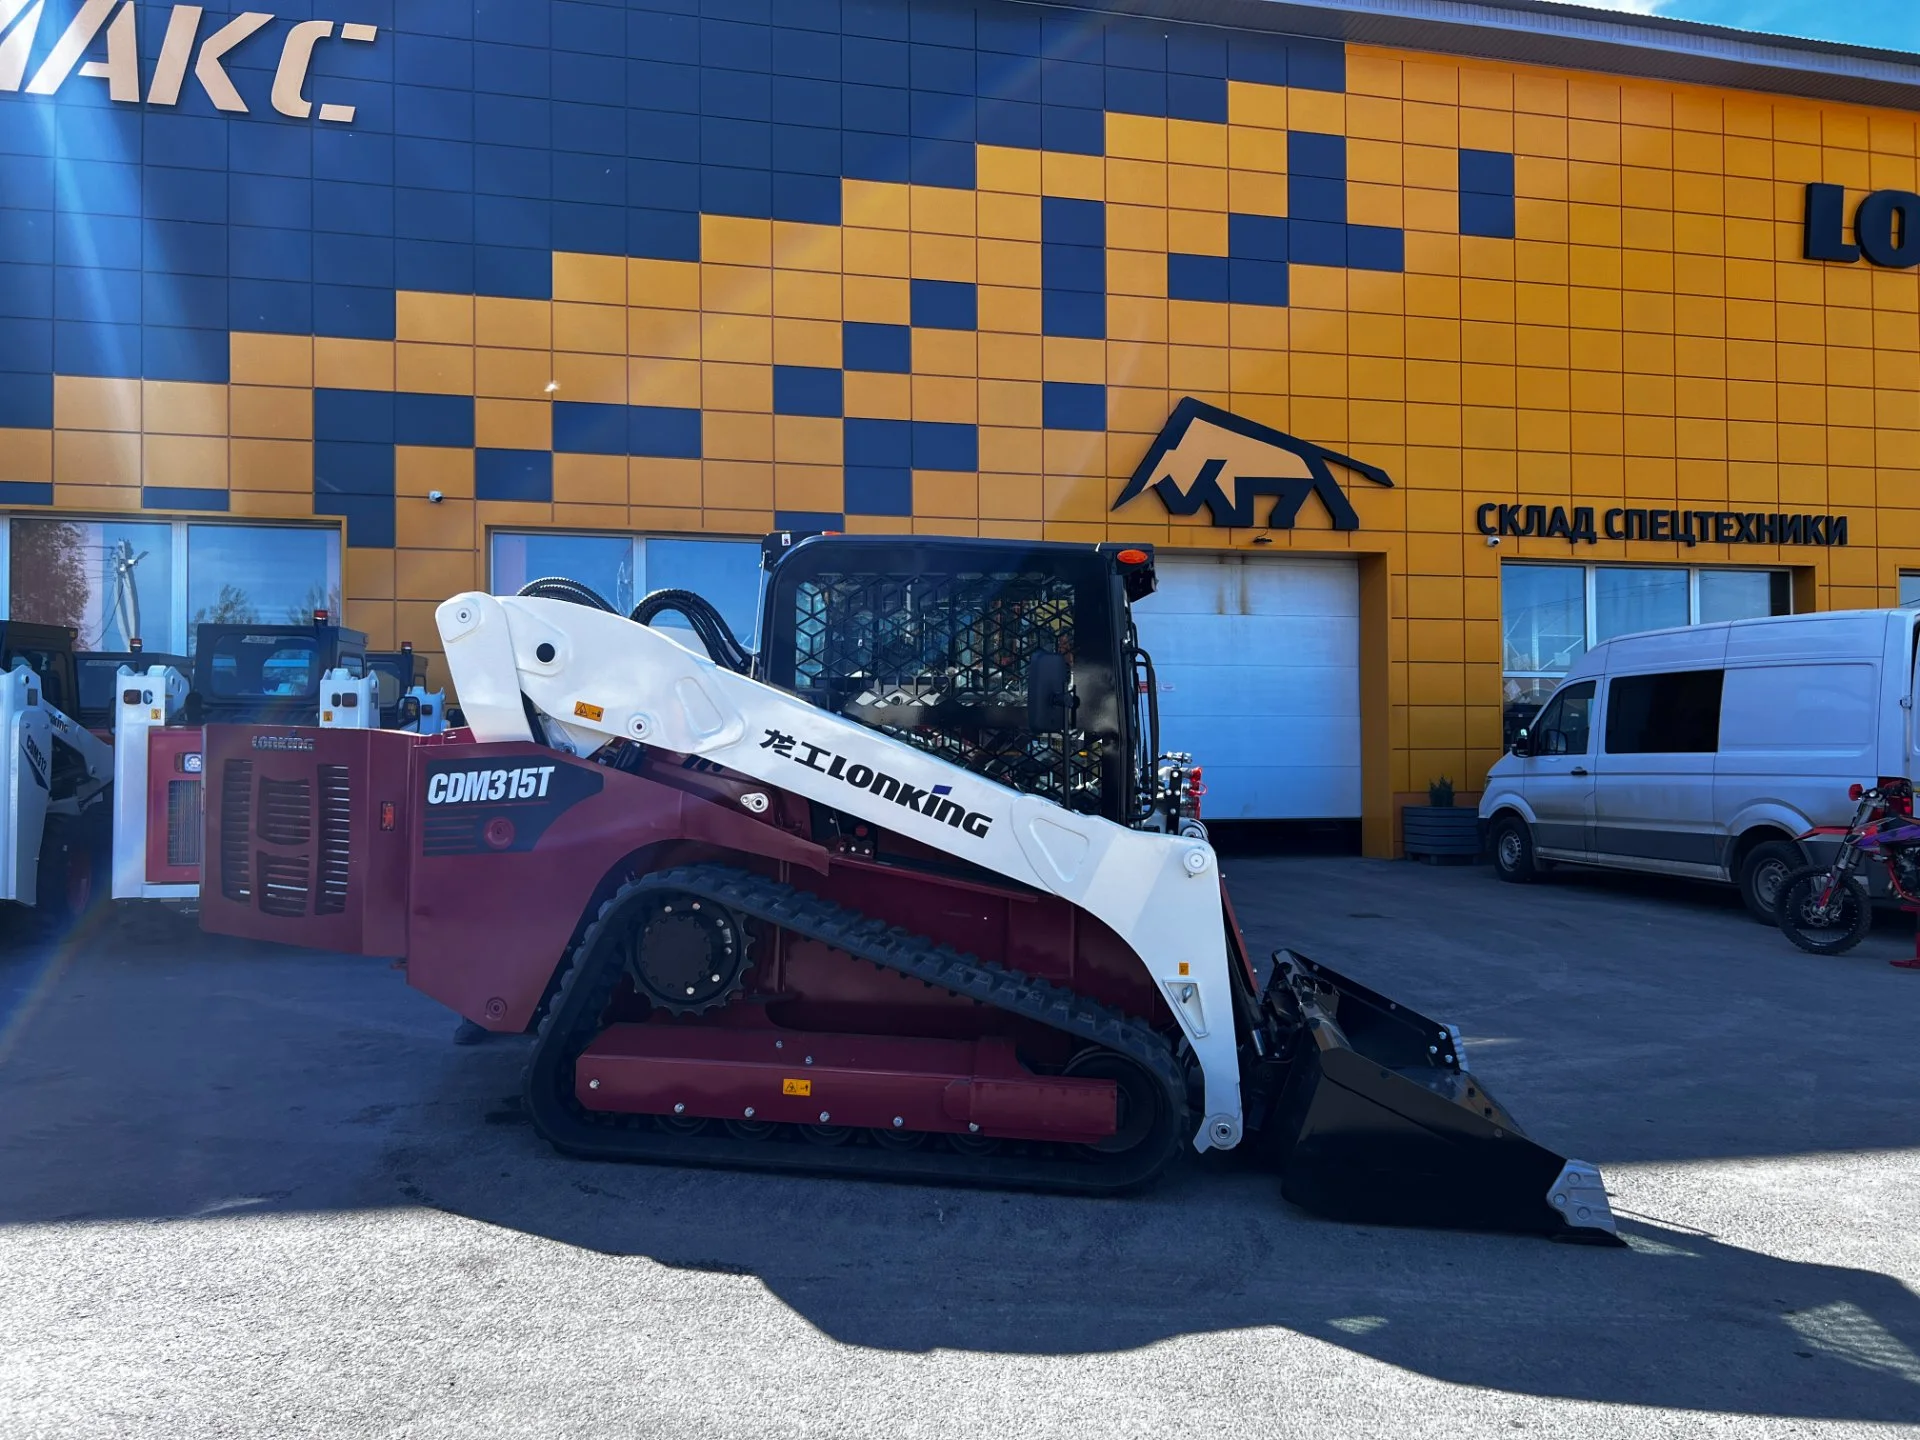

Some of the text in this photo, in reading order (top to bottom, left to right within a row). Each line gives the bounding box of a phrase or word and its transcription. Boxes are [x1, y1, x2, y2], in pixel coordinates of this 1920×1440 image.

[1476, 502, 1848, 547] СКЛАД СПЕЦТЕХНИКИ
[427, 765, 556, 805] CDM315T
